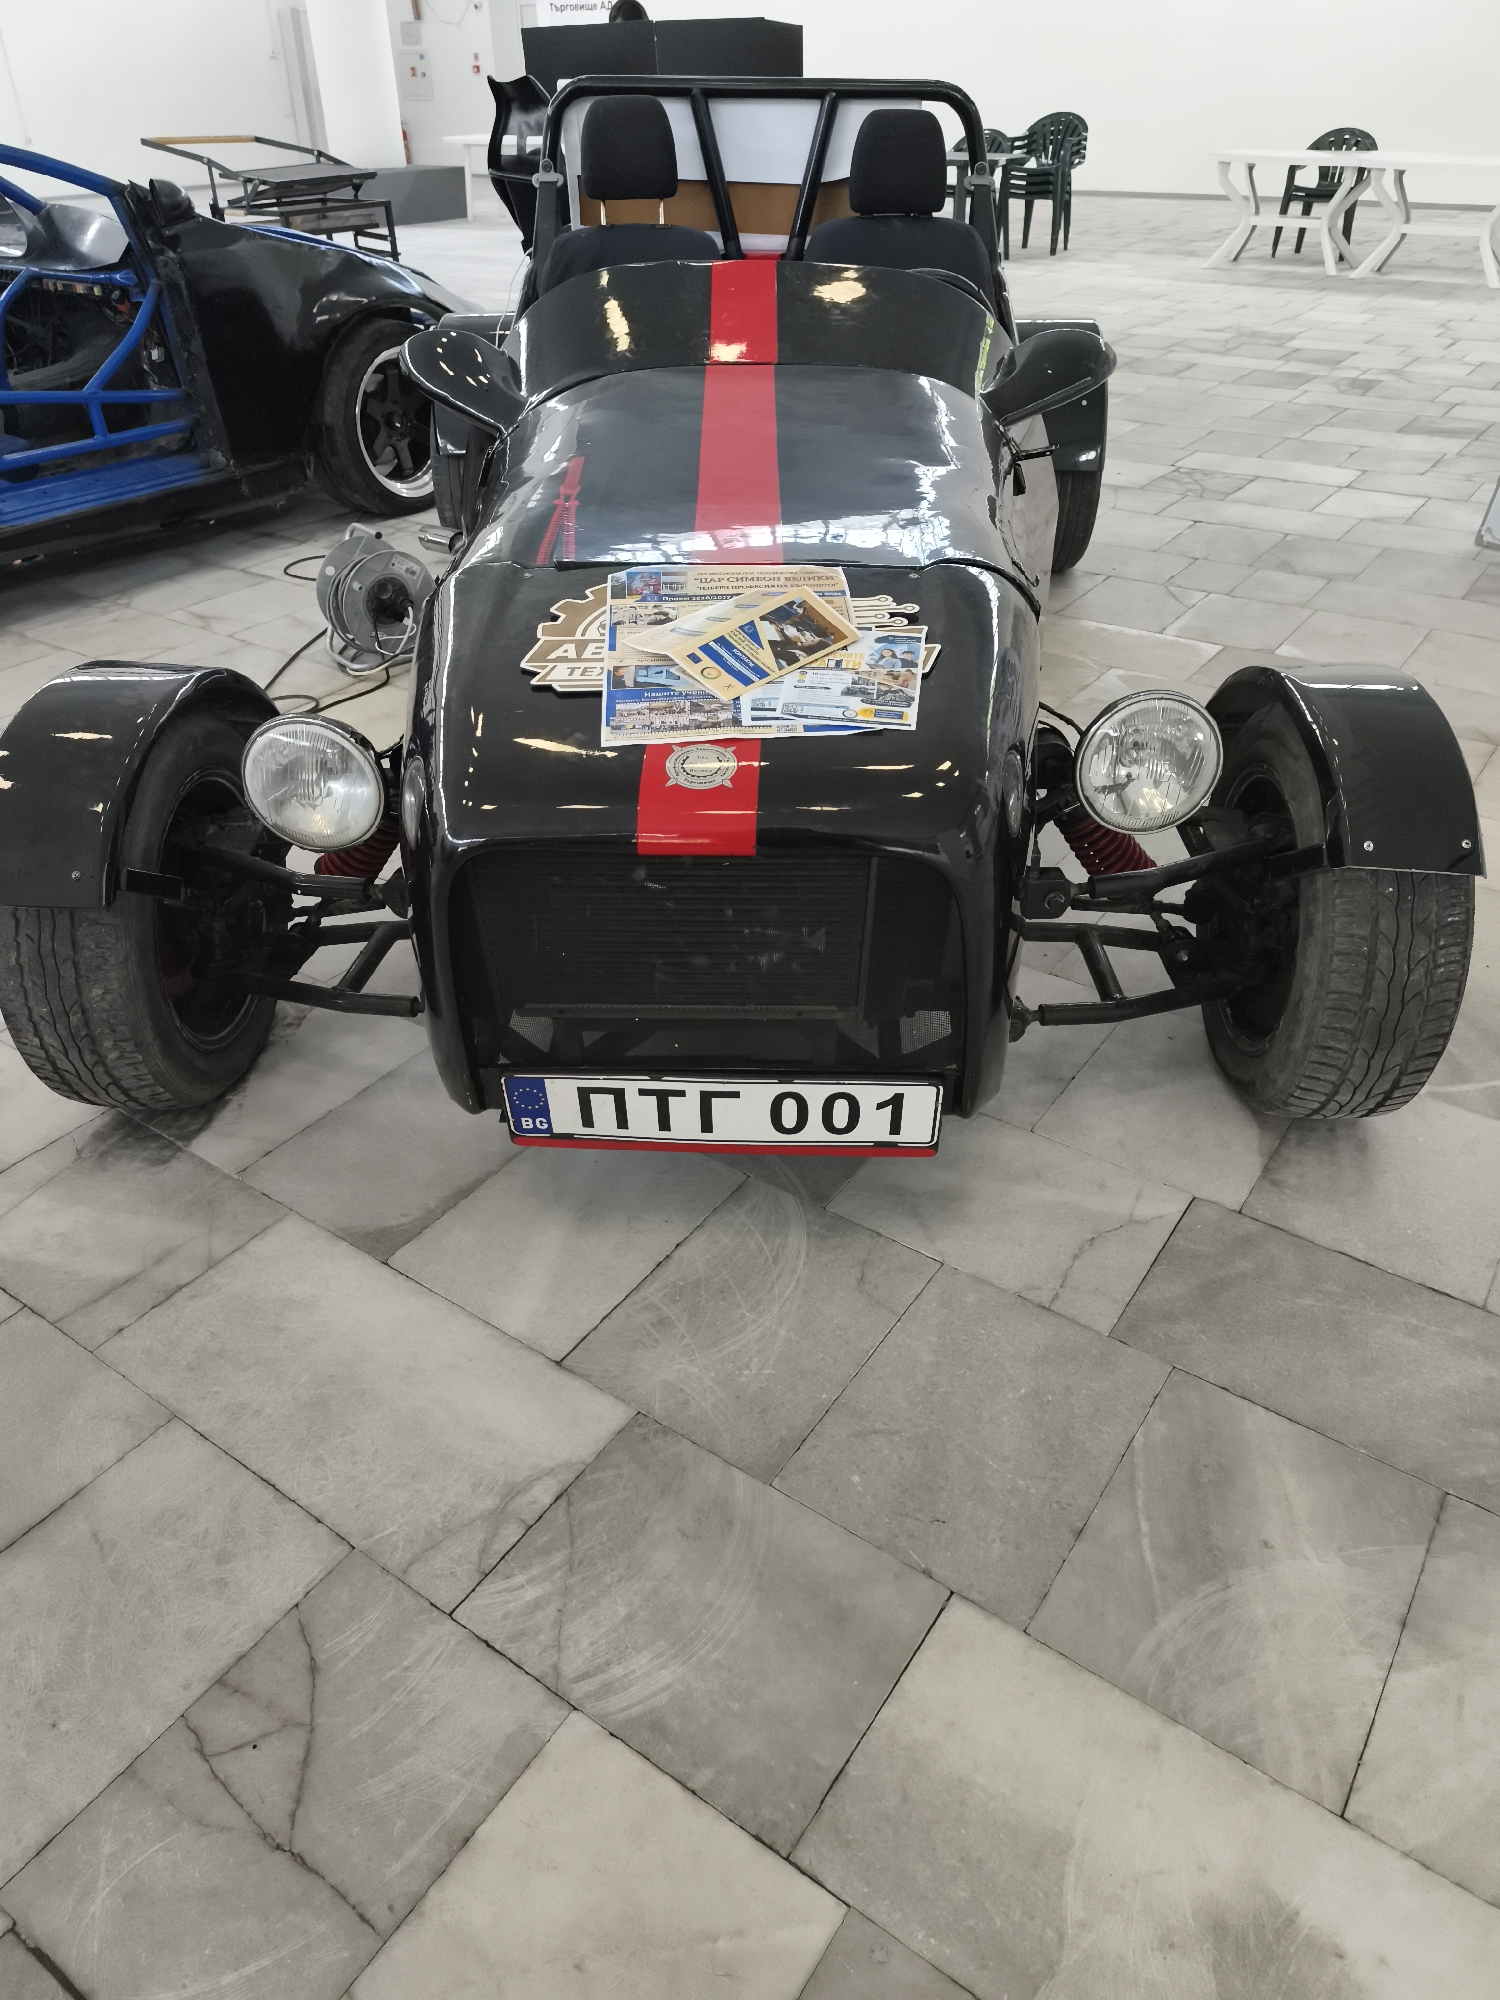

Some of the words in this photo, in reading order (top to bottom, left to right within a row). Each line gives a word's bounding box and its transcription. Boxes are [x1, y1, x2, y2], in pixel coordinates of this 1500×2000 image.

[549, 2, 598, 14] Търговище
[576, 1086, 741, 1133] ПТГ
[769, 1090, 906, 1136] 001
[521, 1117, 549, 1130] BG
